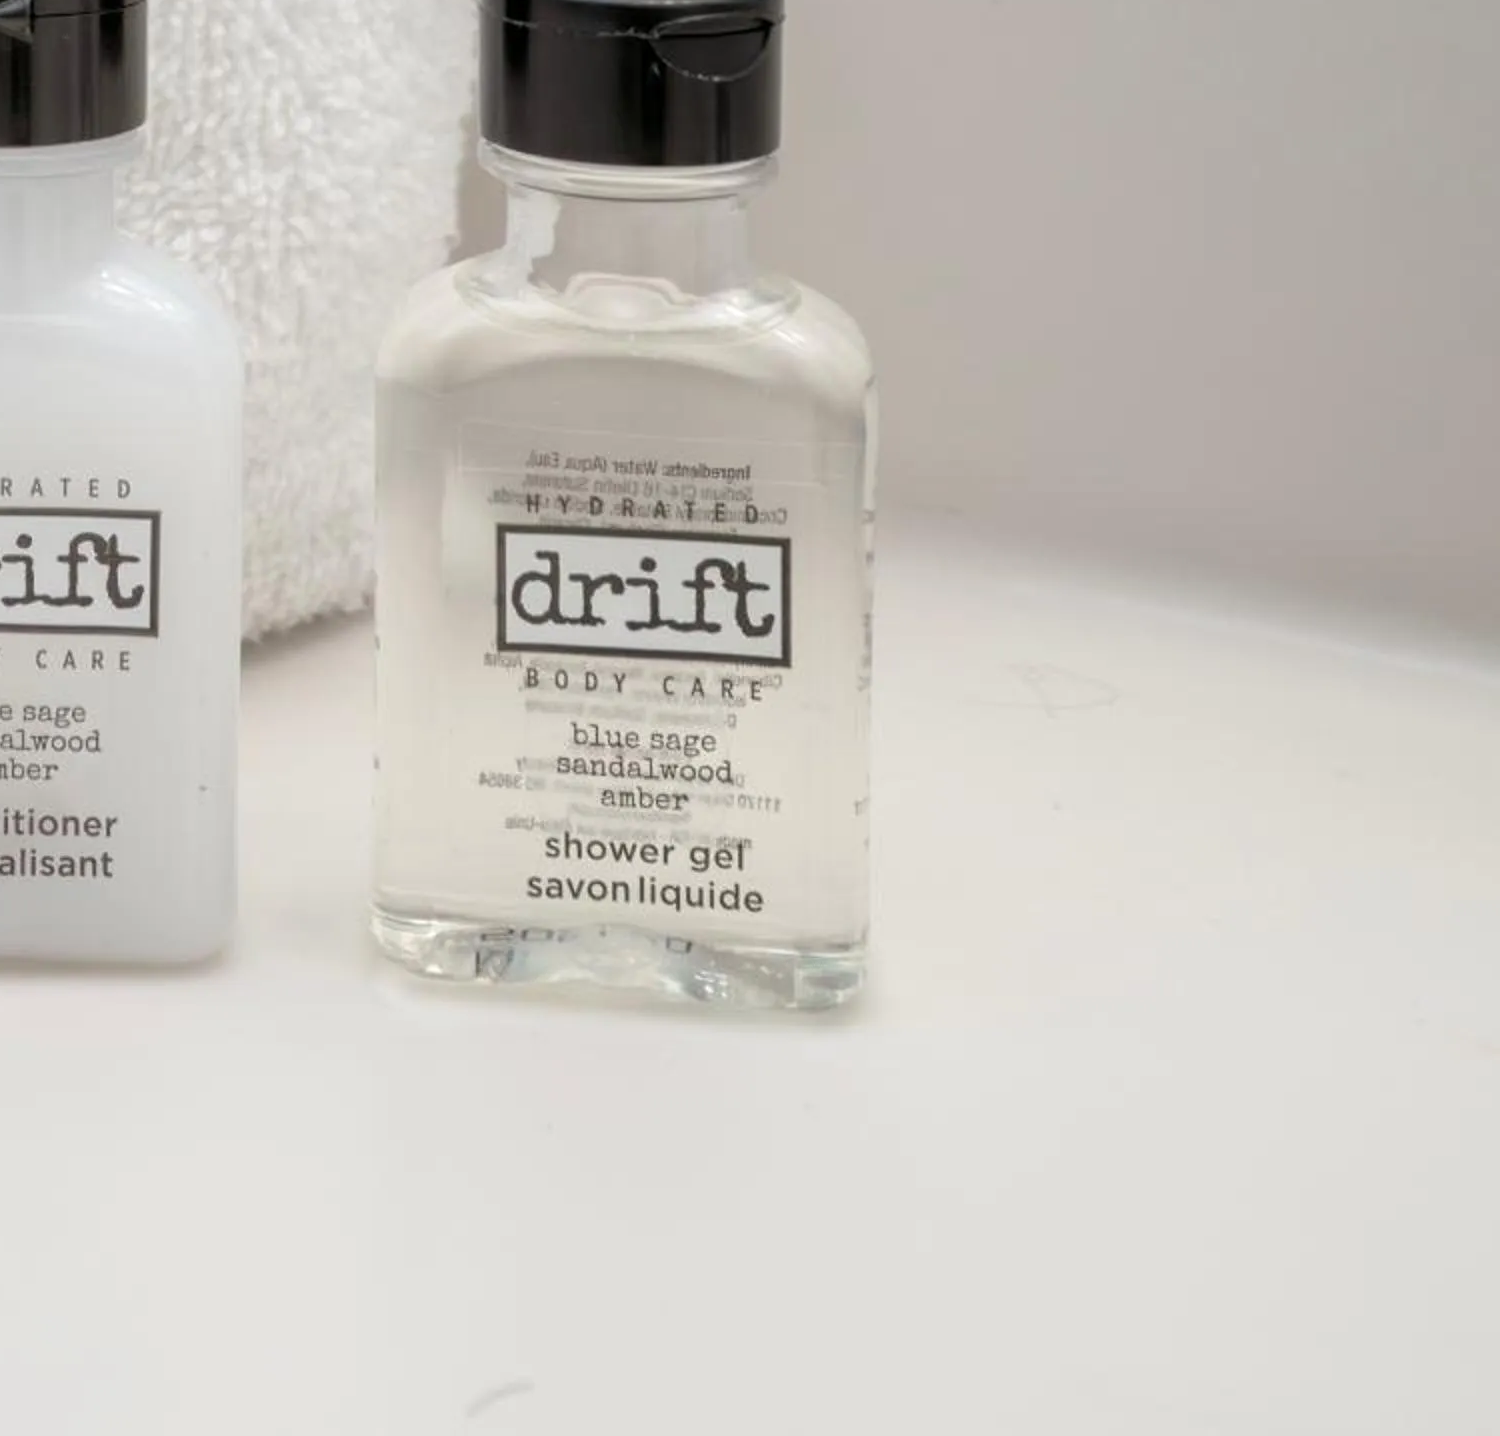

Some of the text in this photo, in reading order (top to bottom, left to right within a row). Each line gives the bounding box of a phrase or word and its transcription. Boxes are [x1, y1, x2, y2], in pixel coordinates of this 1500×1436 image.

[526, 496, 760, 526] HYDRATED
[512, 551, 775, 638] drift
[35, 650, 131, 672] CARE
[526, 667, 627, 695] BODY
[662, 674, 763, 702] CARE
[22, 704, 87, 729] sage
[571, 722, 718, 754] blue sage
[556, 753, 734, 785] sandalwood
[600, 787, 691, 812] amber
[545, 831, 675, 866] shower
[689, 840, 746, 873] gel
[527, 873, 765, 914] savon liquide
